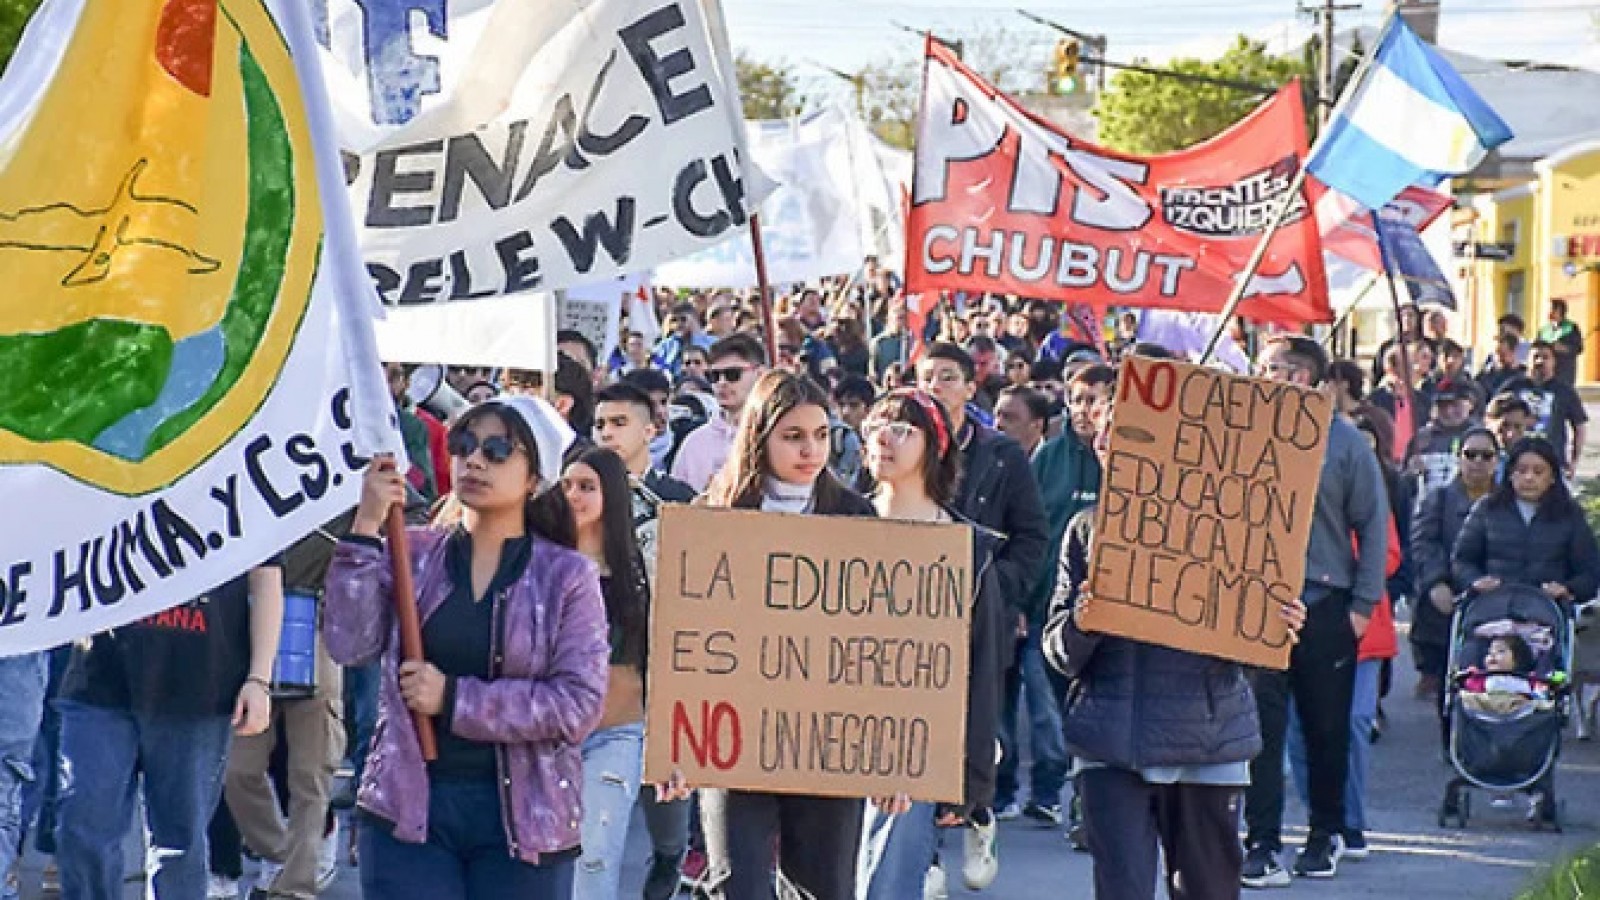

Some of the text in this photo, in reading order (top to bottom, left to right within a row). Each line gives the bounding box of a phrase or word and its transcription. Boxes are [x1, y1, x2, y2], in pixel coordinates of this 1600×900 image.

[912, 55, 1153, 231] PTS
[1165, 189, 1307, 230] IZQUIERA
[921, 226, 1196, 297] CHUBUT
[1121, 359, 1325, 450] NO CAEMOS
[1174, 419, 1281, 481] EN LA
[48, 498, 224, 618] HUMA.
[1243, 519, 1282, 578] LA
[680, 550, 965, 619] LA EDUCACIÓN
[1093, 542, 1291, 648] ELEGIMOS
[672, 630, 951, 690] ES UN DERECHO
[671, 700, 929, 779] NO UN NEGOCIO
